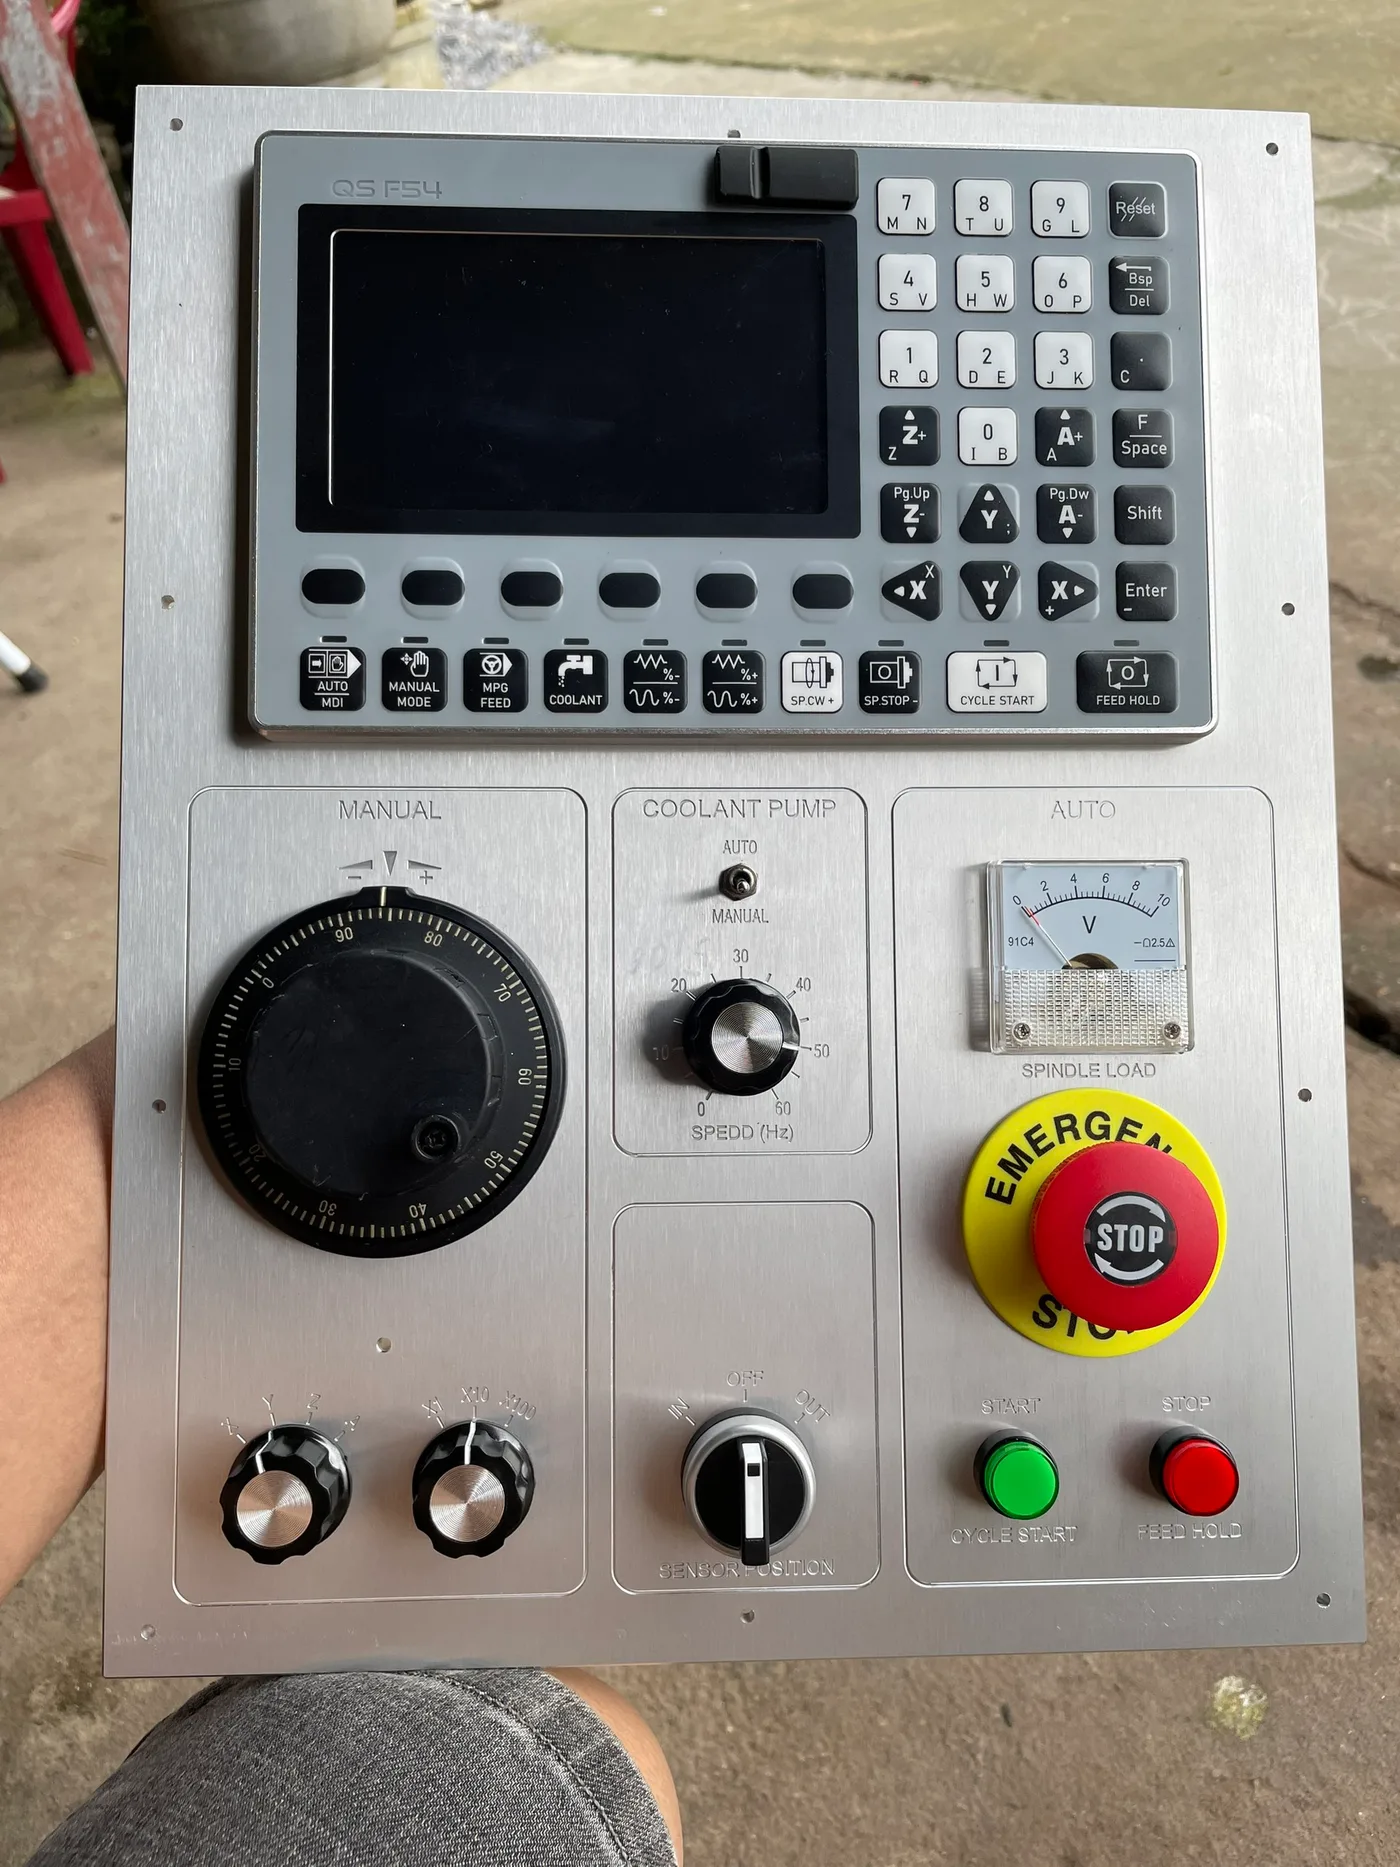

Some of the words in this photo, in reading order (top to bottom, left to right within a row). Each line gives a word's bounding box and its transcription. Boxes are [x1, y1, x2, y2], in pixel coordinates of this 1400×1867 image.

[332, 179, 375, 198] QS
[384, 180, 443, 200] F54
[901, 195, 911, 211] 7
[979, 196, 989, 212] 8
[1056, 197, 1065, 214] 9
[1116, 201, 1156, 215] Reset
[887, 217, 899, 230] M
[917, 217, 927, 231] N
[965, 219, 974, 231] T
[994, 219, 1004, 232] U
[1042, 219, 1052, 232] G
[1071, 220, 1080, 233] L
[903, 271, 914, 287] 4
[981, 271, 991, 288] 5
[1058, 272, 1068, 289] 6
[1129, 272, 1153, 287] Bsp
[889, 293, 899, 306] S
[918, 293, 928, 306] V
[967, 294, 976, 307] H
[993, 294, 1008, 307] W
[1073, 295, 1082, 308] P
[1129, 295, 1150, 307] Del
[906, 347, 912, 364] 1
[982, 348, 992, 365] 2
[1059, 349, 1069, 365] 3
[890, 370, 899, 383] R
[918, 370, 929, 383] Q
[969, 371, 978, 384] D
[997, 371, 1006, 384] E
[1047, 372, 1054, 385] J
[1074, 372, 1083, 385] K
[1120, 370, 1129, 383] C
[1138, 414, 1148, 430] F
[983, 423, 993, 441] 0
[888, 447, 897, 461] Z
[971, 447, 977, 461] I
[998, 448, 1007, 461] B
[1046, 447, 1057, 462] A
[1121, 441, 1167, 458] Space
[894, 487, 930, 502] Pg.Up
[1050, 488, 1089, 503] Pg.Dw
[980, 509, 998, 529] Y
[1127, 506, 1162, 520] Shift
[925, 565, 934, 579] X
[1002, 565, 1012, 579] Y
[909, 580, 927, 601] X
[982, 580, 1000, 601] Y
[1051, 580, 1068, 601] X
[1125, 583, 1167, 598] Enter
[317, 681, 349, 692] AUTO
[389, 681, 440, 692] MANUAL
[483, 682, 508, 694] MPG
[322, 697, 344, 708] MDI
[397, 696, 431, 708] MODE
[480, 697, 511, 709] FEED
[549, 695, 603, 706] COOLANT
[791, 695, 825, 706] SP.CW
[864, 695, 910, 706] SP.STOP
[960, 695, 996, 706] CYCLE
[999, 695, 1035, 706] START
[1096, 695, 1126, 706] FEED
[1129, 695, 1160, 706] HOLD
[338, 800, 442, 820] MANUAL
[643, 799, 762, 819] COOLANT
[769, 799, 836, 819] PUMP
[1051, 800, 1116, 820] AUTO
[722, 839, 758, 854] AUTO
[1039, 880, 1049, 892] 2
[1070, 873, 1078, 883] 4
[1102, 873, 1109, 883] 6
[1131, 880, 1141, 892] 8
[1012, 895, 1022, 906] 0
[1157, 892, 1171, 907] 10
[711, 908, 769, 924] MANUAL
[1082, 915, 1097, 934] V
[334, 926, 355, 943] 90
[423, 929, 444, 947] 80
[1007, 936, 1034, 947] 91C4
[732, 948, 749, 963] 30
[262, 977, 275, 989] 0
[670, 977, 687, 993] 20
[795, 977, 812, 992] 40
[492, 982, 513, 1003] 70
[813, 1043, 830, 1058] 50
[228, 1058, 241, 1071] 10
[1022, 1062, 1100, 1079] SPINDLE
[1107, 1062, 1156, 1078] LOAD
[518, 1067, 533, 1086] 60
[697, 1101, 705, 1117] 0
[775, 1101, 791, 1116] 60
[691, 1124, 754, 1141] SPEDD
[759, 1124, 794, 1143] (Hz)
[248, 1143, 267, 1162] 20
[483, 1150, 504, 1170] 50
[318, 1199, 338, 1216] 30
[408, 1202, 428, 1219] 40
[1097, 1224, 1163, 1253] STOP
[1032, 1293, 1135, 1340] ST
[726, 1371, 764, 1387] OFF
[262, 1393, 274, 1411] Y
[307, 1393, 321, 1410] Z
[460, 1386, 489, 1403] X10
[667, 1397, 690, 1420] IN
[794, 1388, 831, 1424] OUT
[981, 1397, 1041, 1415] START
[1162, 1395, 1212, 1413] STOP
[220, 1416, 239, 1436] X
[950, 1528, 1013, 1545] CYCLE
[1018, 1526, 1077, 1543] START
[1137, 1523, 1186, 1541] FEED
[1192, 1522, 1242, 1540] HOLD
[659, 1561, 740, 1579] SENSOR
